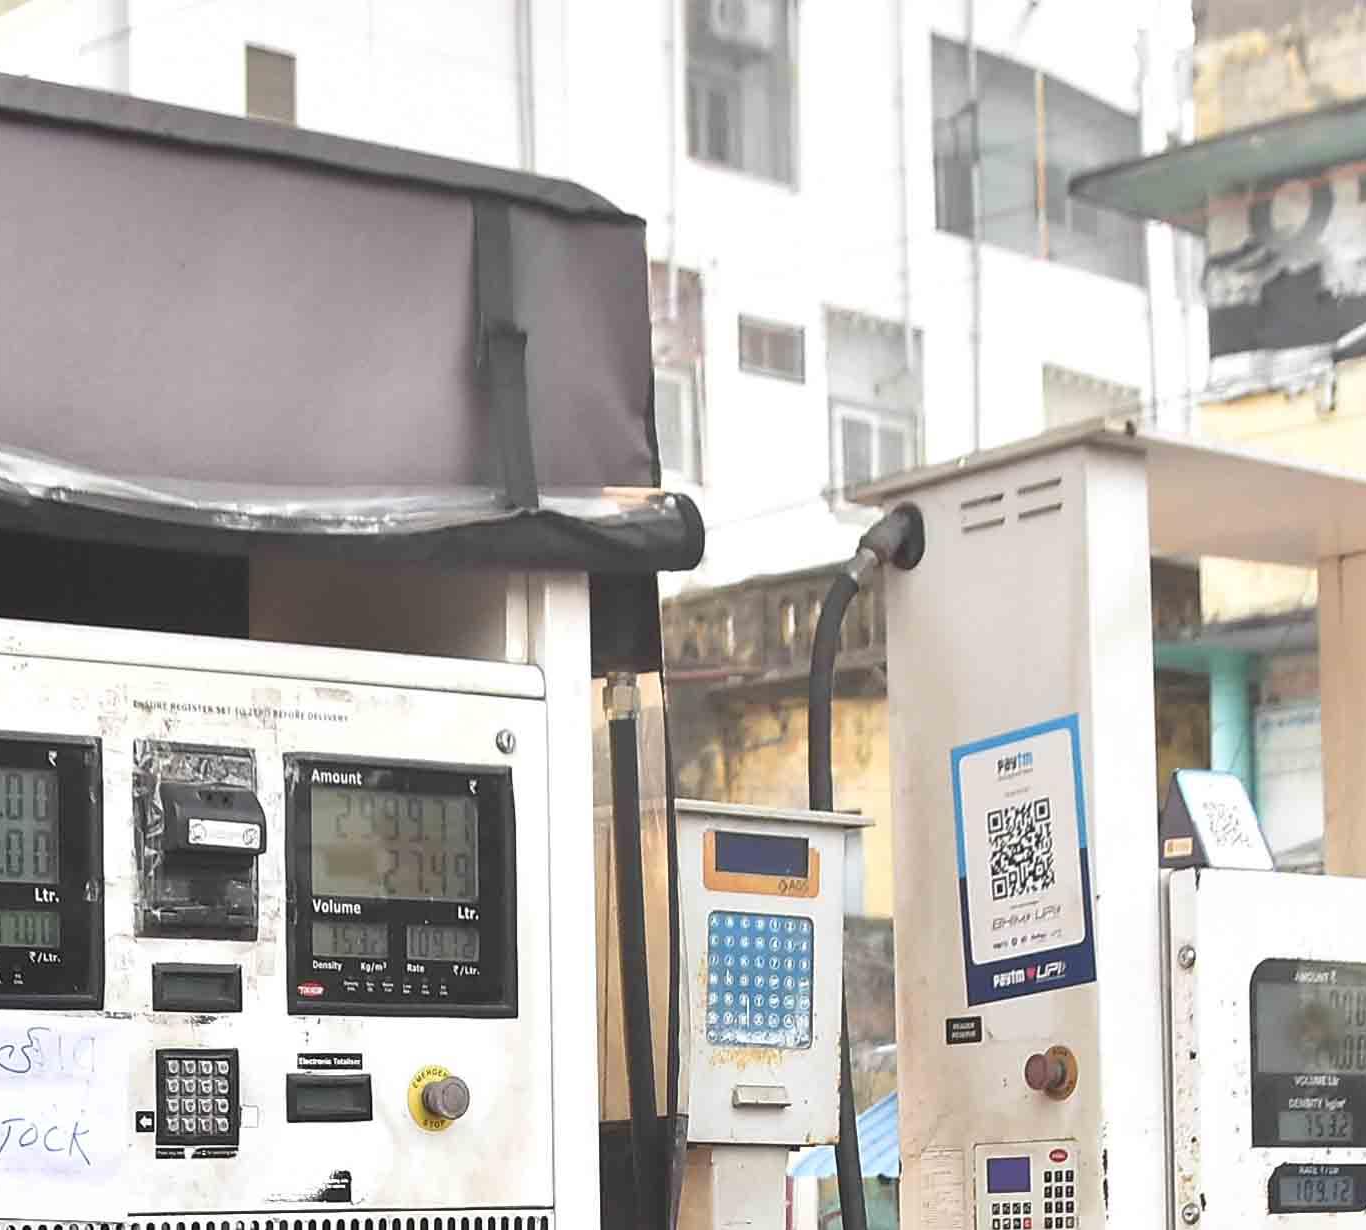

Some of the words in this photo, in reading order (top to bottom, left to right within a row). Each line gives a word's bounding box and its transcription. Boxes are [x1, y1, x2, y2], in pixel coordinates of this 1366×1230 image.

[312, 770, 362, 785] Amount
[35, 888, 60, 903] Ltr.
[313, 900, 361, 914] Volume
[458, 907, 479, 920] Ltr.
[313, 961, 343, 971] Density
[407, 964, 425, 973] Rate
